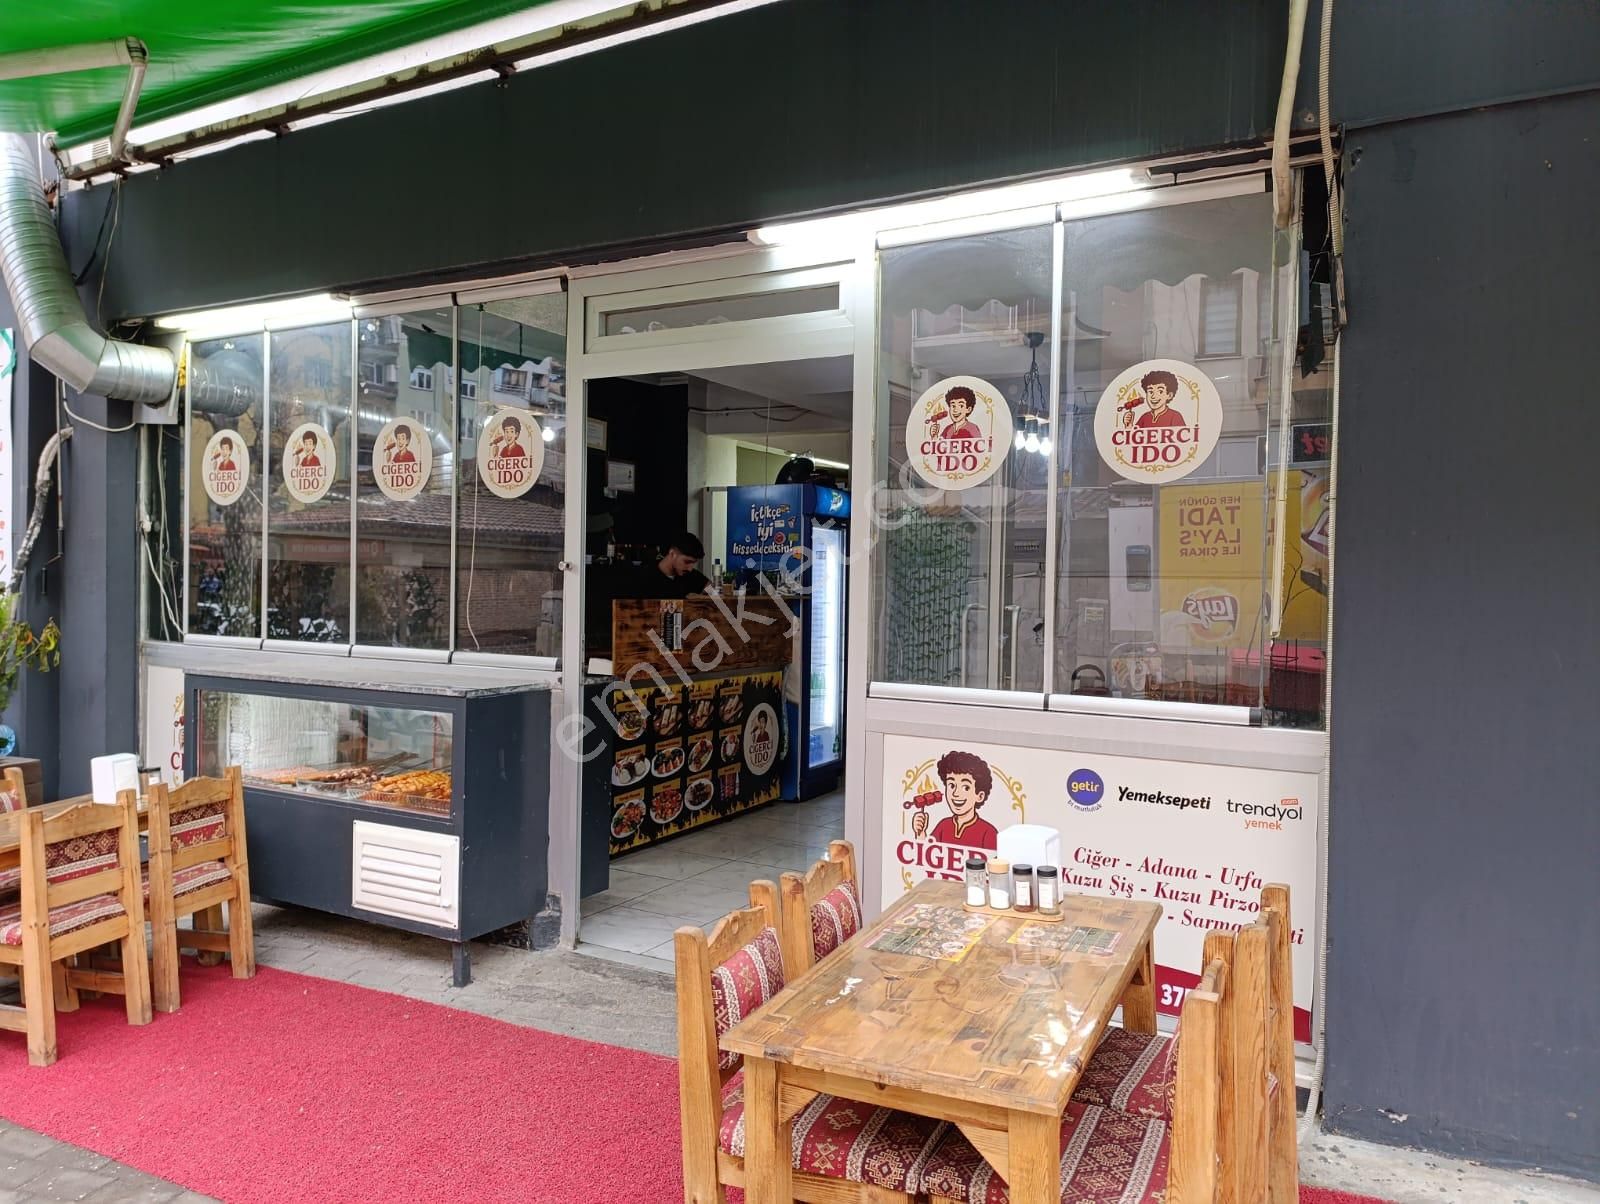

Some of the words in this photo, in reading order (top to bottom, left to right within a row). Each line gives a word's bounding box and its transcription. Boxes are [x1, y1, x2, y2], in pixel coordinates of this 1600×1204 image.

[757, 523, 774, 541] iyi
[1071, 781, 1100, 793] getir
[1118, 786, 1211, 810] Yemeksepeti
[1227, 799, 1303, 821] trendyol
[1244, 819, 1282, 831] yemek
[1073, 847, 1120, 870] Ciğer
[1138, 856, 1197, 880] Adana
[1220, 867, 1262, 891] Urfa
[1061, 867, 1103, 889] Kuzu
[1110, 874, 1134, 898] Şiş
[1153, 881, 1201, 904] Kuzu
[1208, 889, 1261, 913] Pirzo
